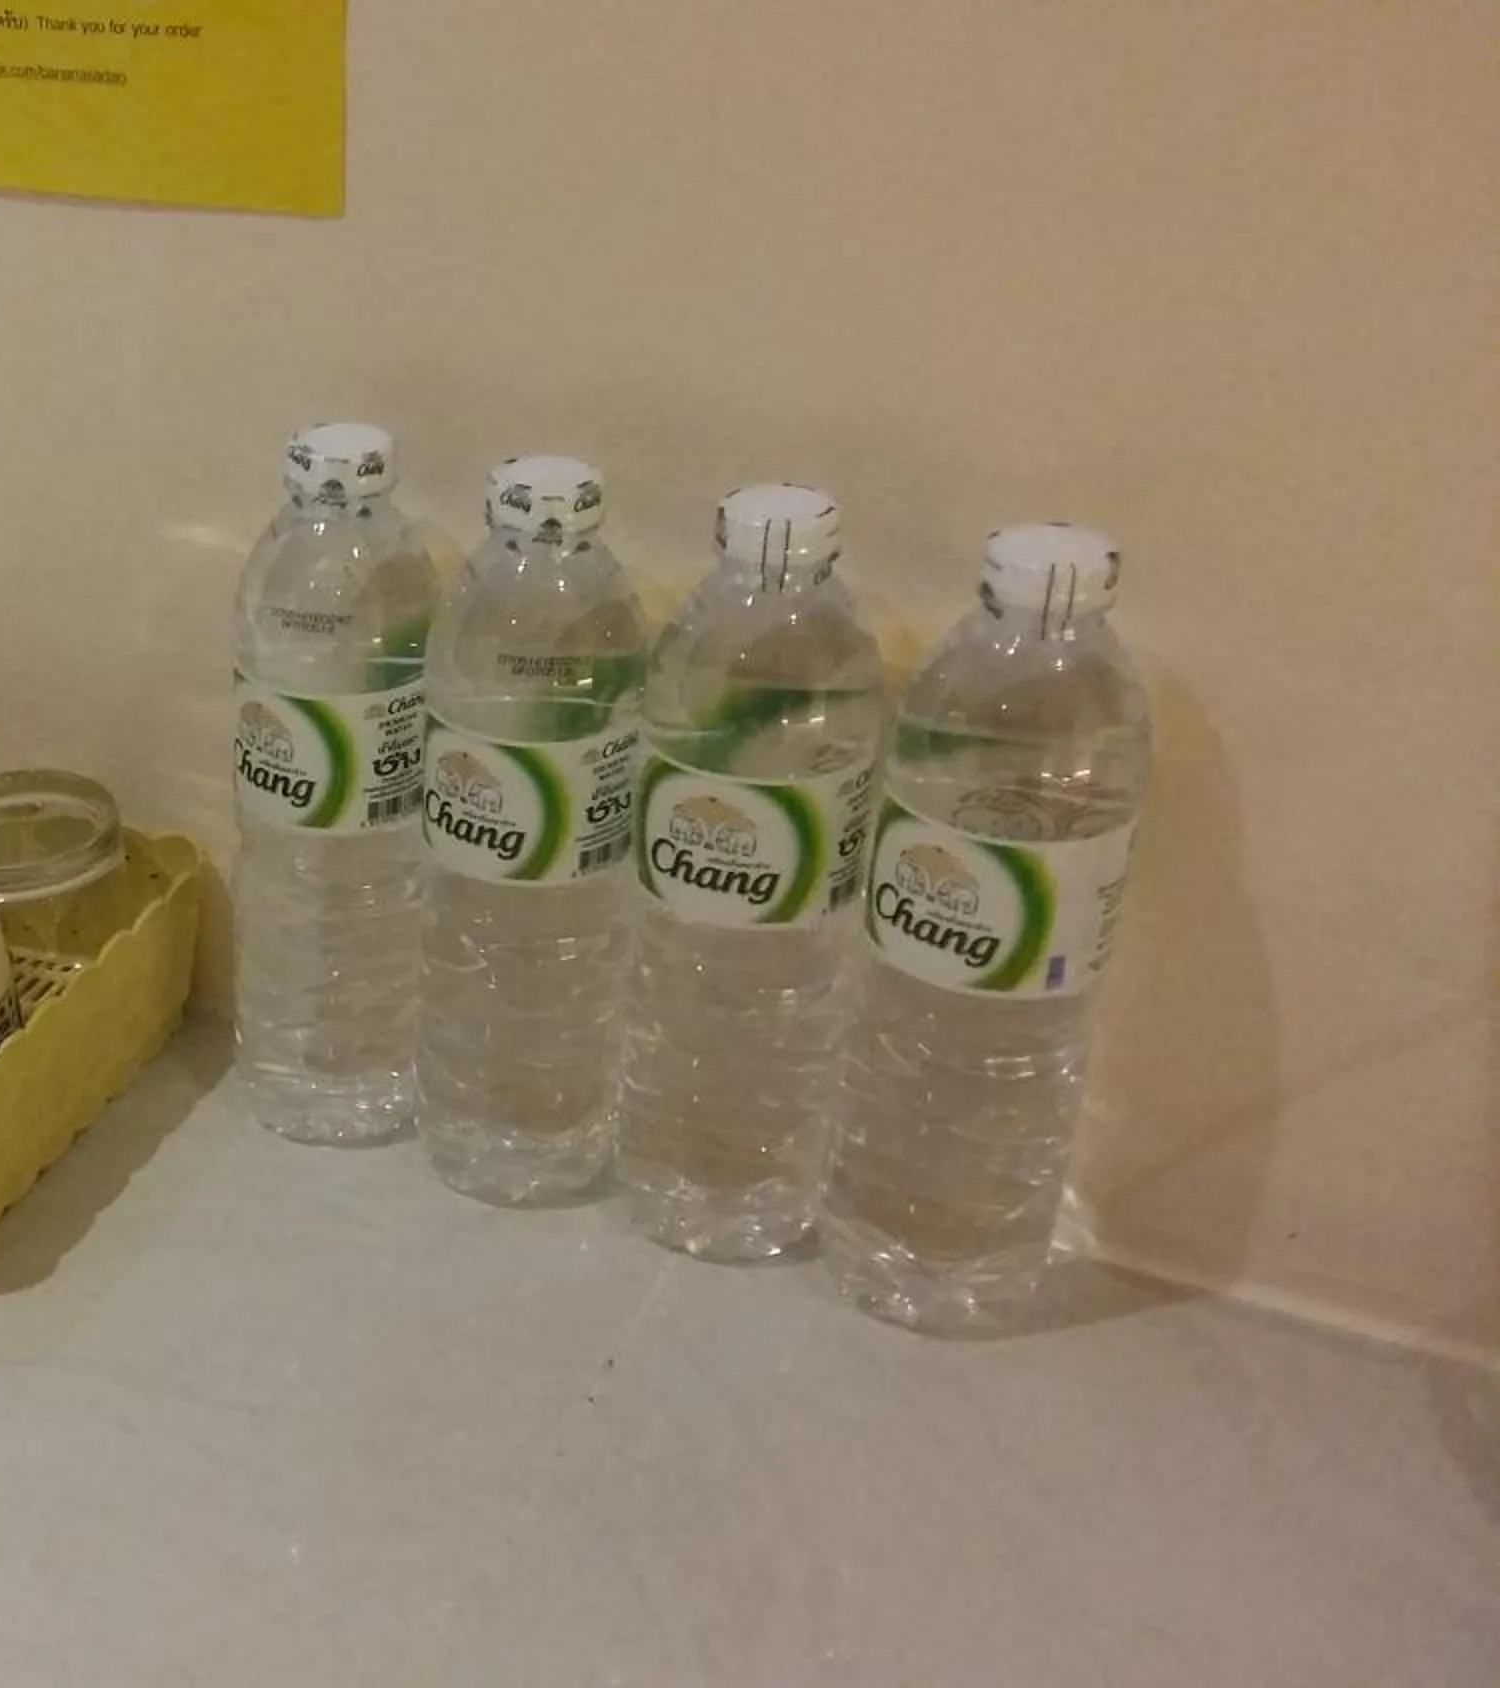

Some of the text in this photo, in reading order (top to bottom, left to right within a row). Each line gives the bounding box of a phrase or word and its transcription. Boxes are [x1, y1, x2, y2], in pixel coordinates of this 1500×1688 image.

[36, 15, 77, 32] Thank
[80, 20, 106, 35] you
[109, 19, 127, 34] for
[131, 22, 160, 39] your
[165, 24, 203, 39] order
[425, 787, 527, 861] Chang
[651, 837, 781, 906] Chang
[875, 882, 1000, 969] Chang
